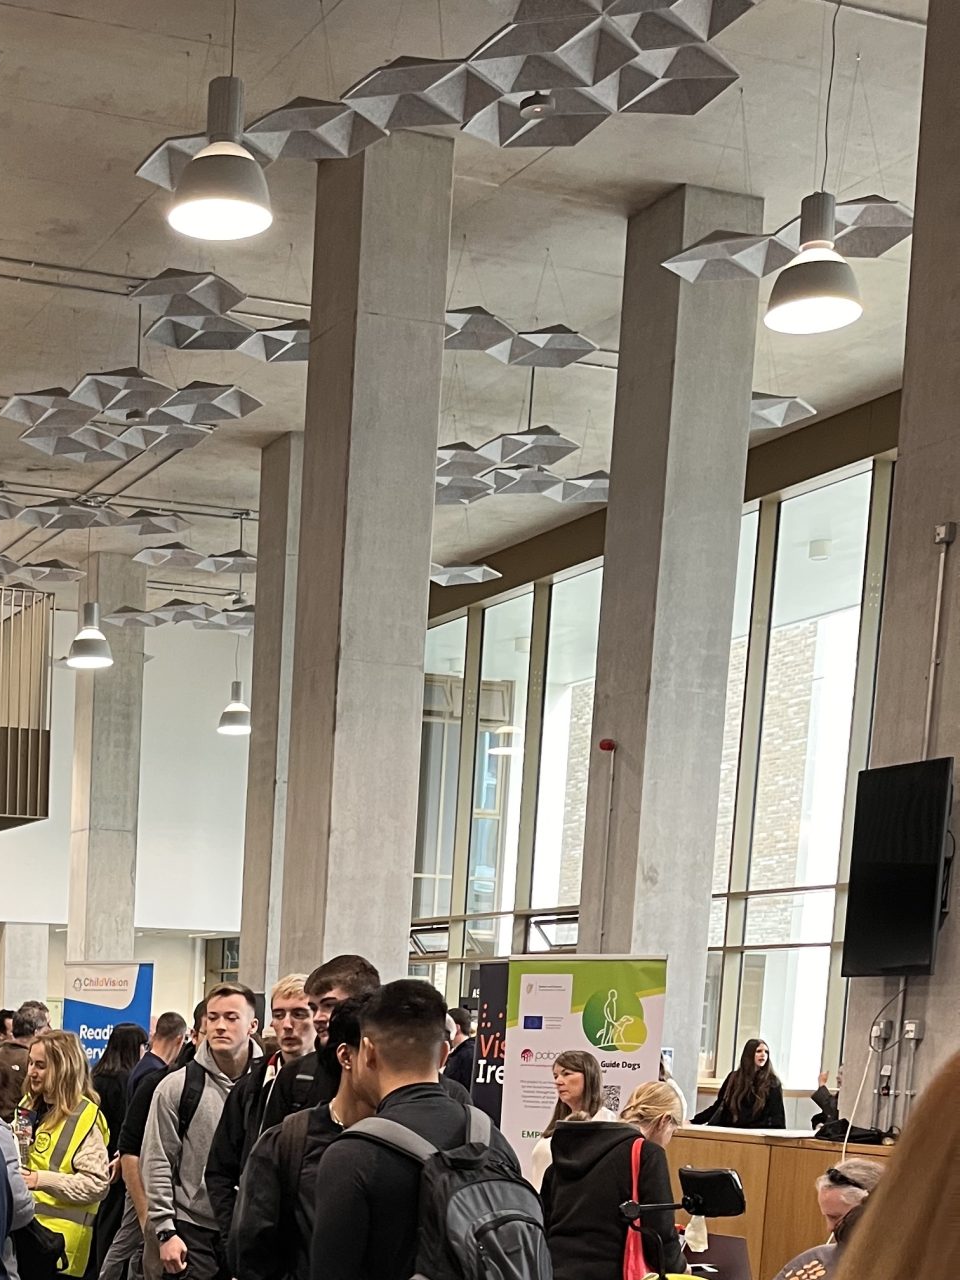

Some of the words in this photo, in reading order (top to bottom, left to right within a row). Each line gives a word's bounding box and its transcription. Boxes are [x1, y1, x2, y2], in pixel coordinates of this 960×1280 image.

[83, 977, 128, 987] ChildVision
[600, 1060, 620, 1069] Guide
[622, 1061, 641, 1070] Dogs
[522, 1130, 541, 1138] EMP
